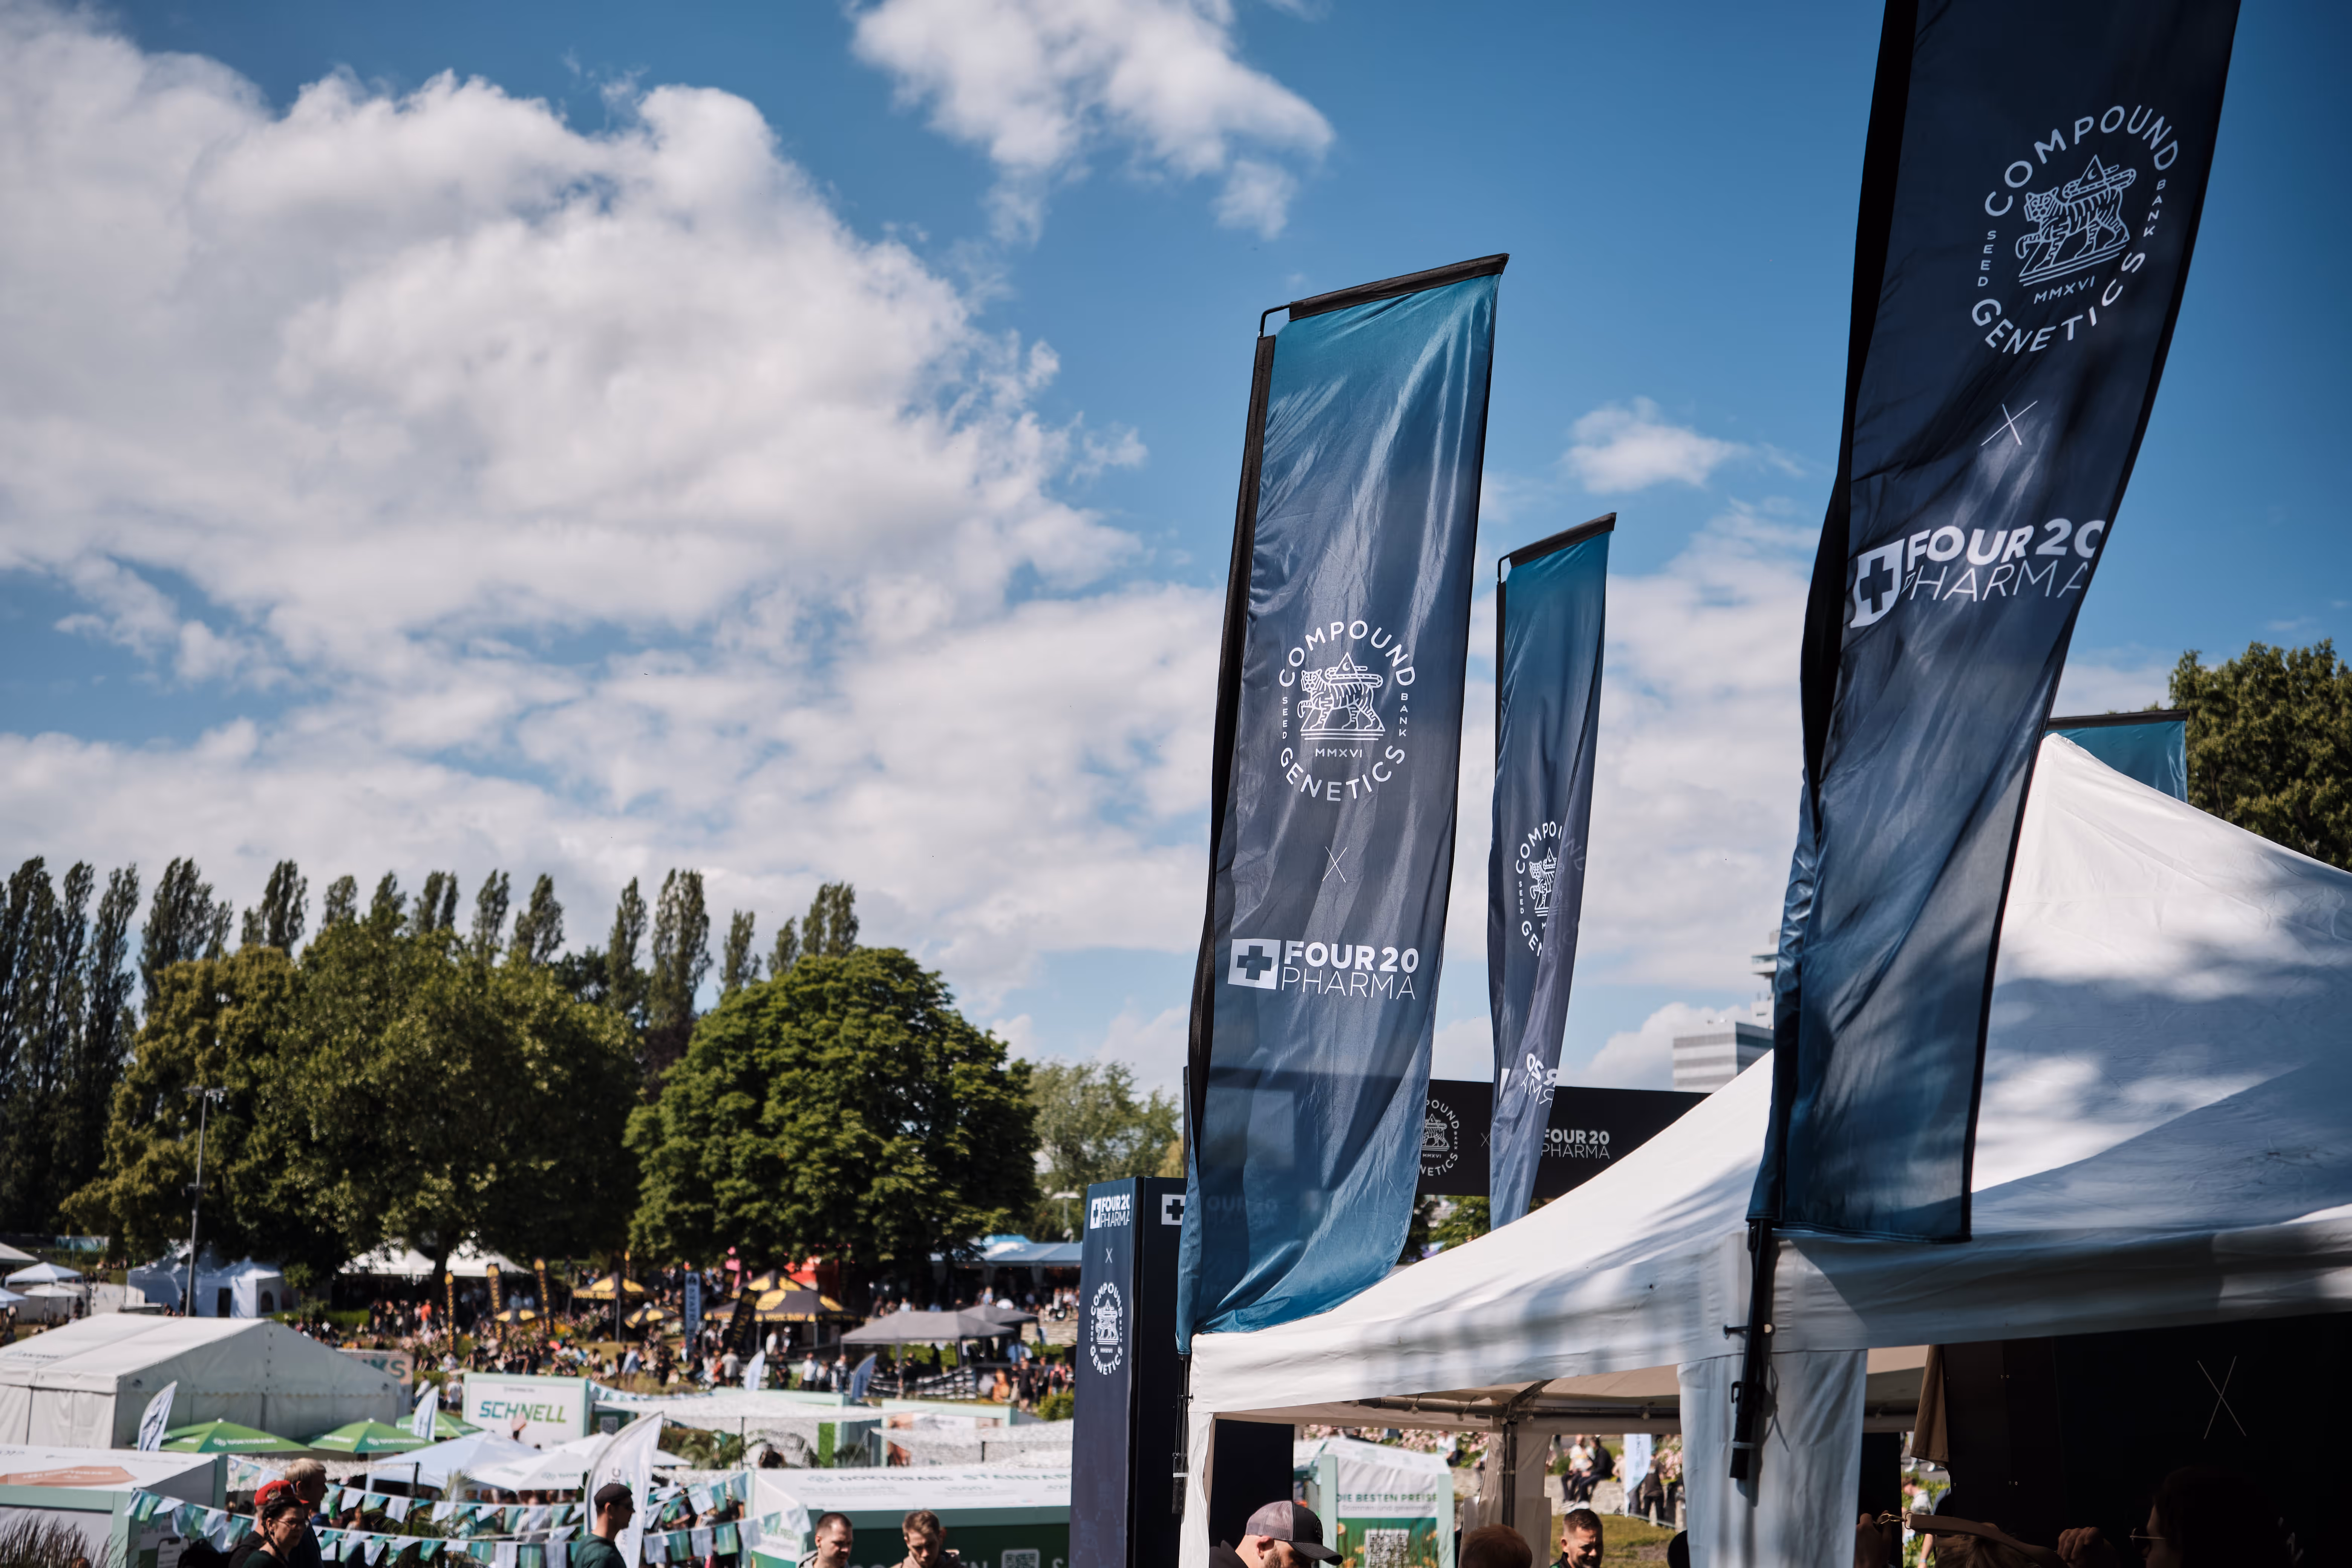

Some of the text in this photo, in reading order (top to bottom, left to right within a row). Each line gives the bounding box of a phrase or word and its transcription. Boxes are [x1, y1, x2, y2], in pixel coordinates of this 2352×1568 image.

[1985, 105, 2179, 217] COMPOUND
[2143, 179, 2166, 237] BANK
[1978, 231, 1996, 287] SEED
[1972, 252, 2145, 355] GENETICS
[2034, 276, 2095, 304] MMXVI
[1279, 620, 1415, 687] COMPOUND
[1398, 692, 1408, 737] BANK
[1315, 748, 1363, 758] MMXVI
[1280, 745, 1405, 802] GENETICS
[1516, 821, 1563, 874] COMPO
[1282, 966, 1416, 1000] PHARMA
[1420, 1153, 1458, 1176] NETICS
[1541, 1143, 1610, 1159] PHARMA
[1090, 1282, 1123, 1317] COMPOUND
[1090, 1345, 1123, 1375] GENETICS
[479, 1401, 567, 1424] SCHNELL
[1337, 1494, 1438, 1502] DIE BESTEN PREISE
